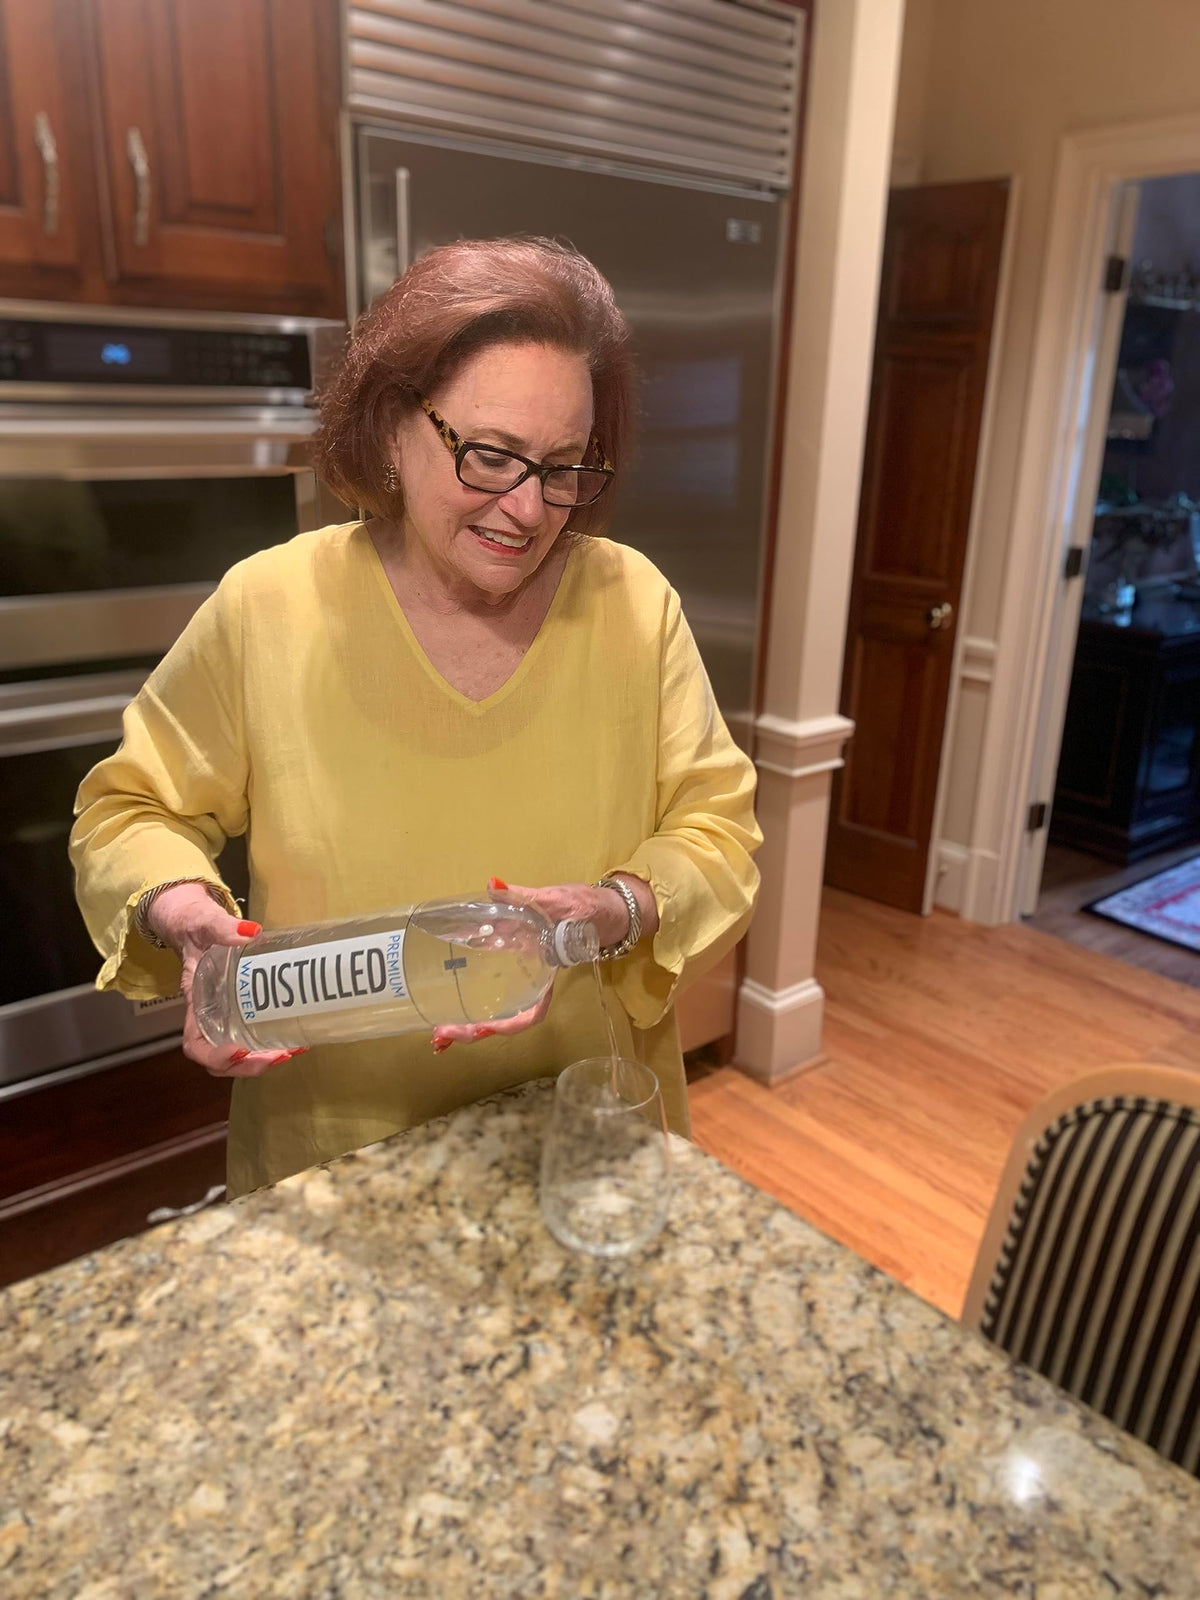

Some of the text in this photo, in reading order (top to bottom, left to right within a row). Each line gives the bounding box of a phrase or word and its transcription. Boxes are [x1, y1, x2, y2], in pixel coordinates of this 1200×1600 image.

[237, 960, 255, 1020] WATER
[251, 947, 386, 1011] DISTILLED
[386, 934, 405, 998] PREMIUM
